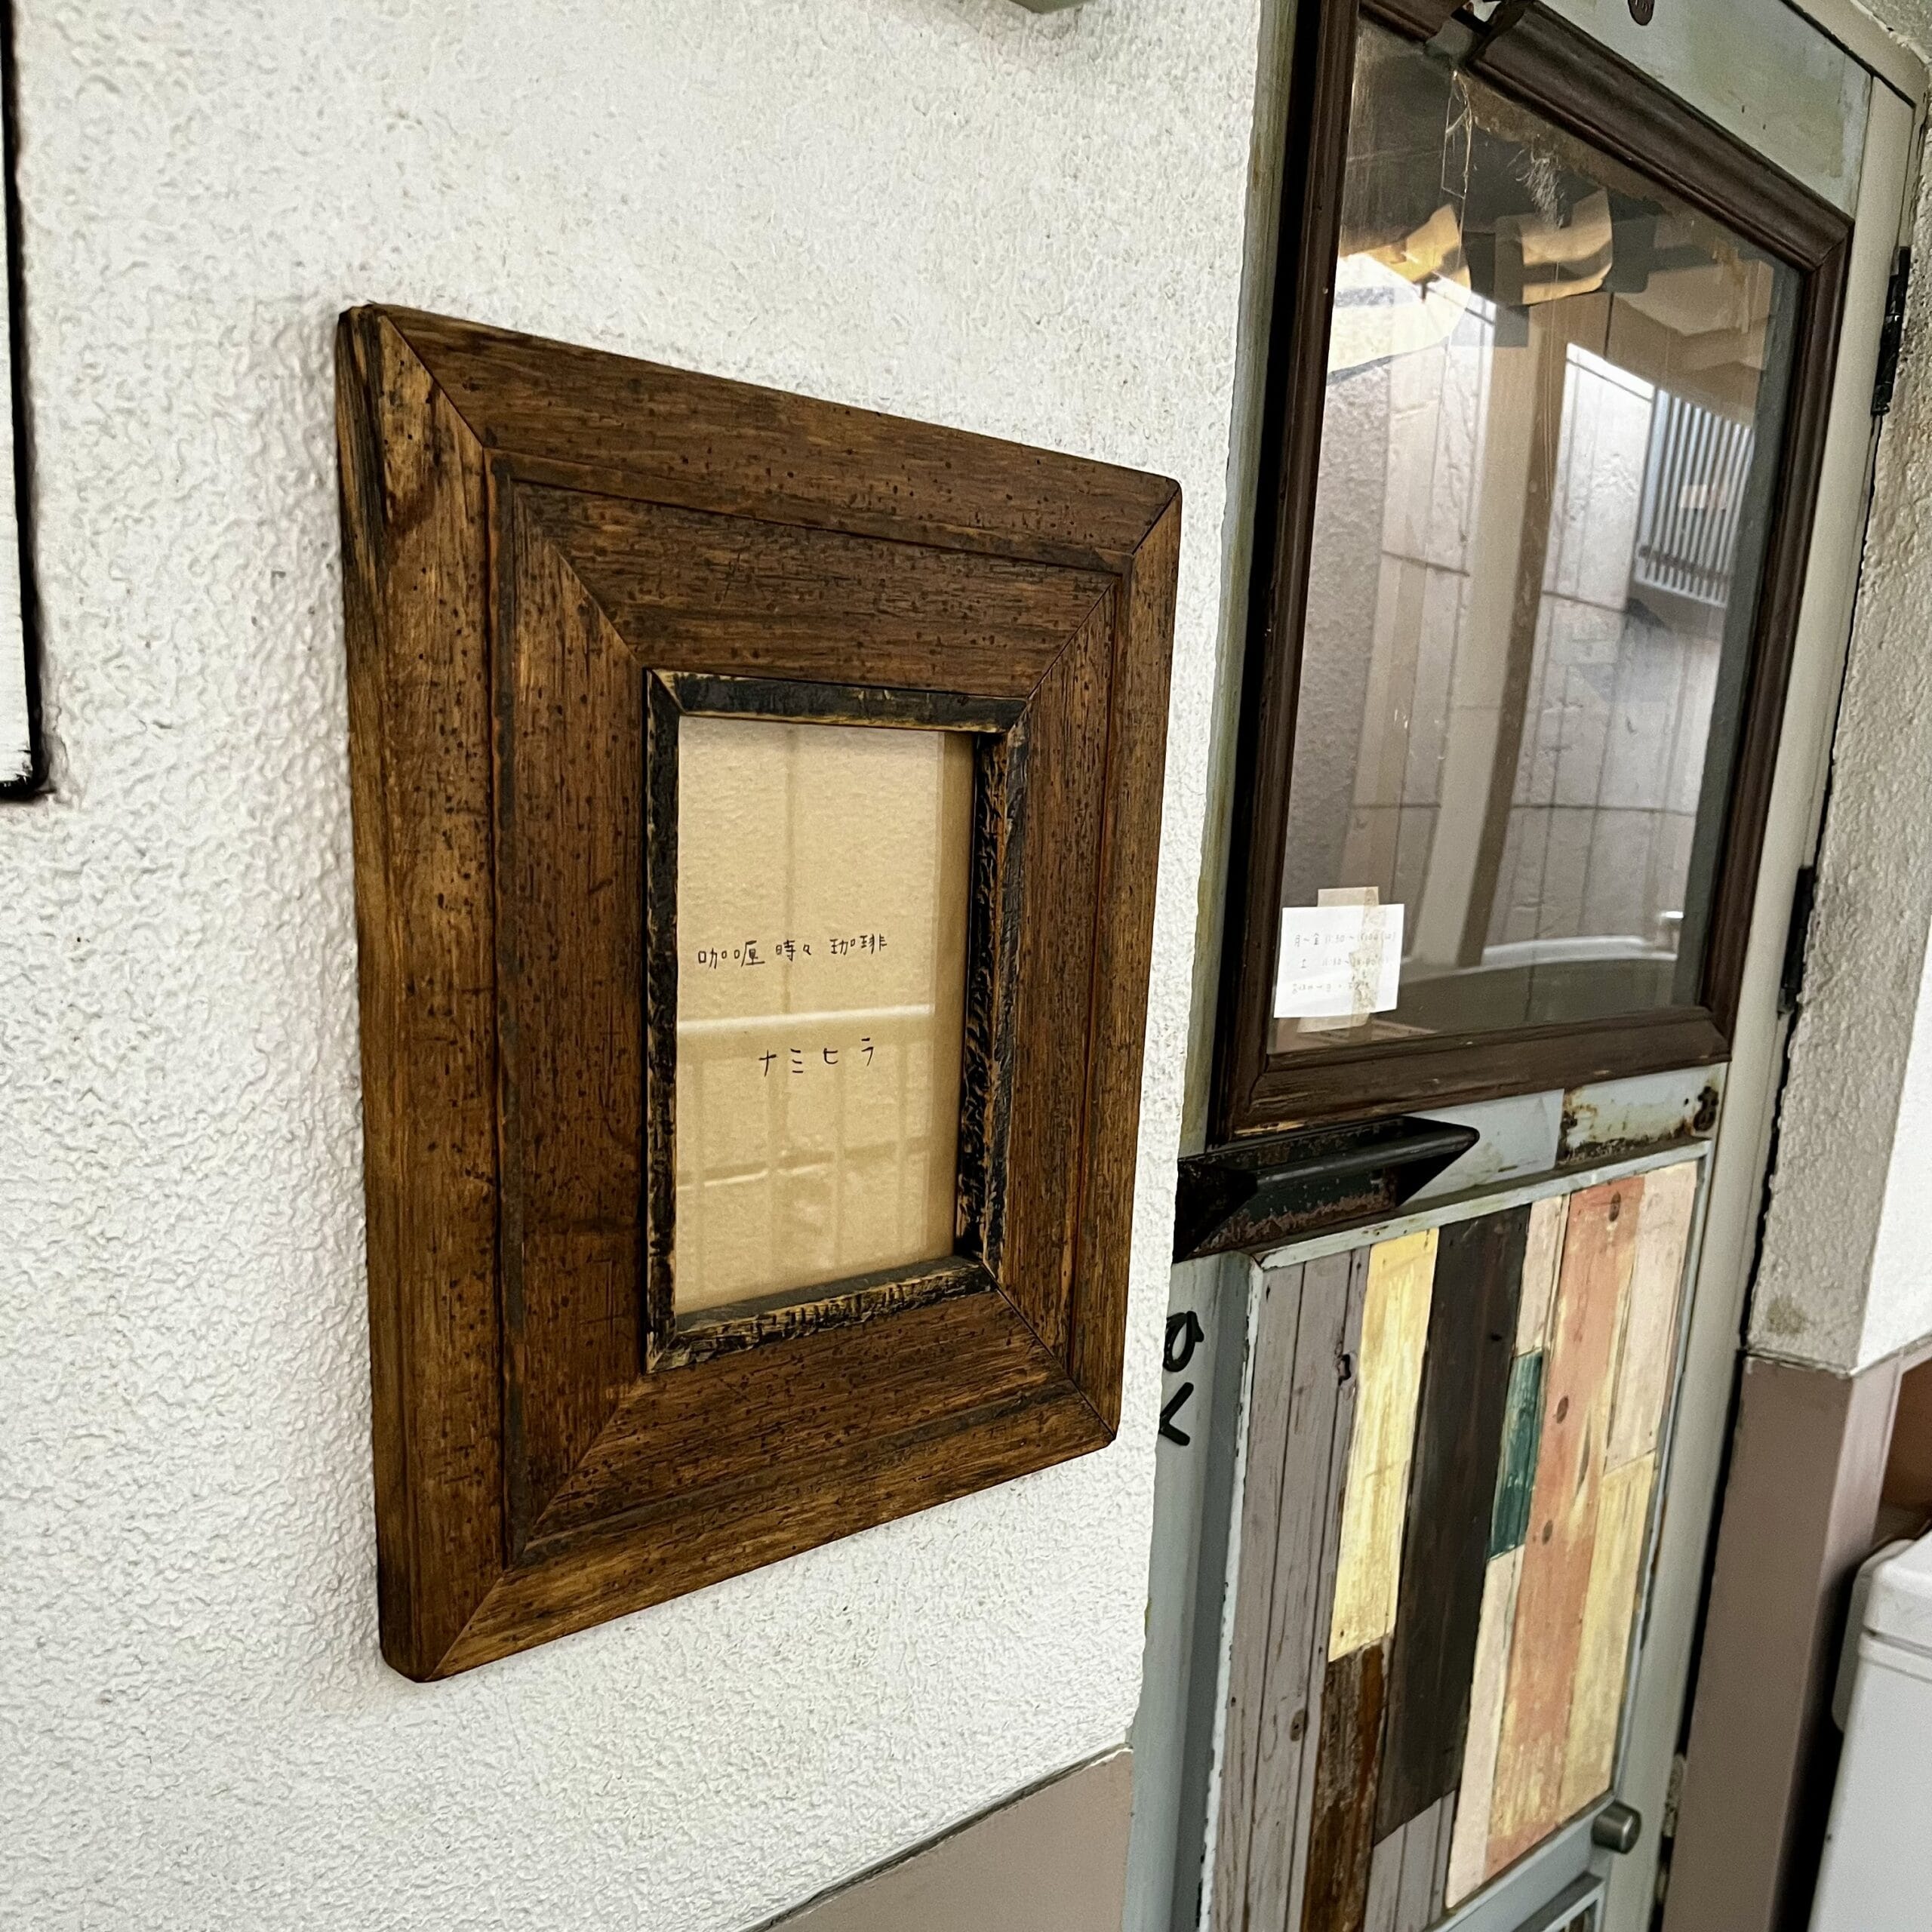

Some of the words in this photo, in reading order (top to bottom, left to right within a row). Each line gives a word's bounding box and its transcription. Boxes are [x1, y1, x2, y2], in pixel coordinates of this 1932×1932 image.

[775, 940, 811, 961] 時々
[829, 934, 888, 955] 珈琲
[758, 1037, 874, 1077] ナミヒラ
